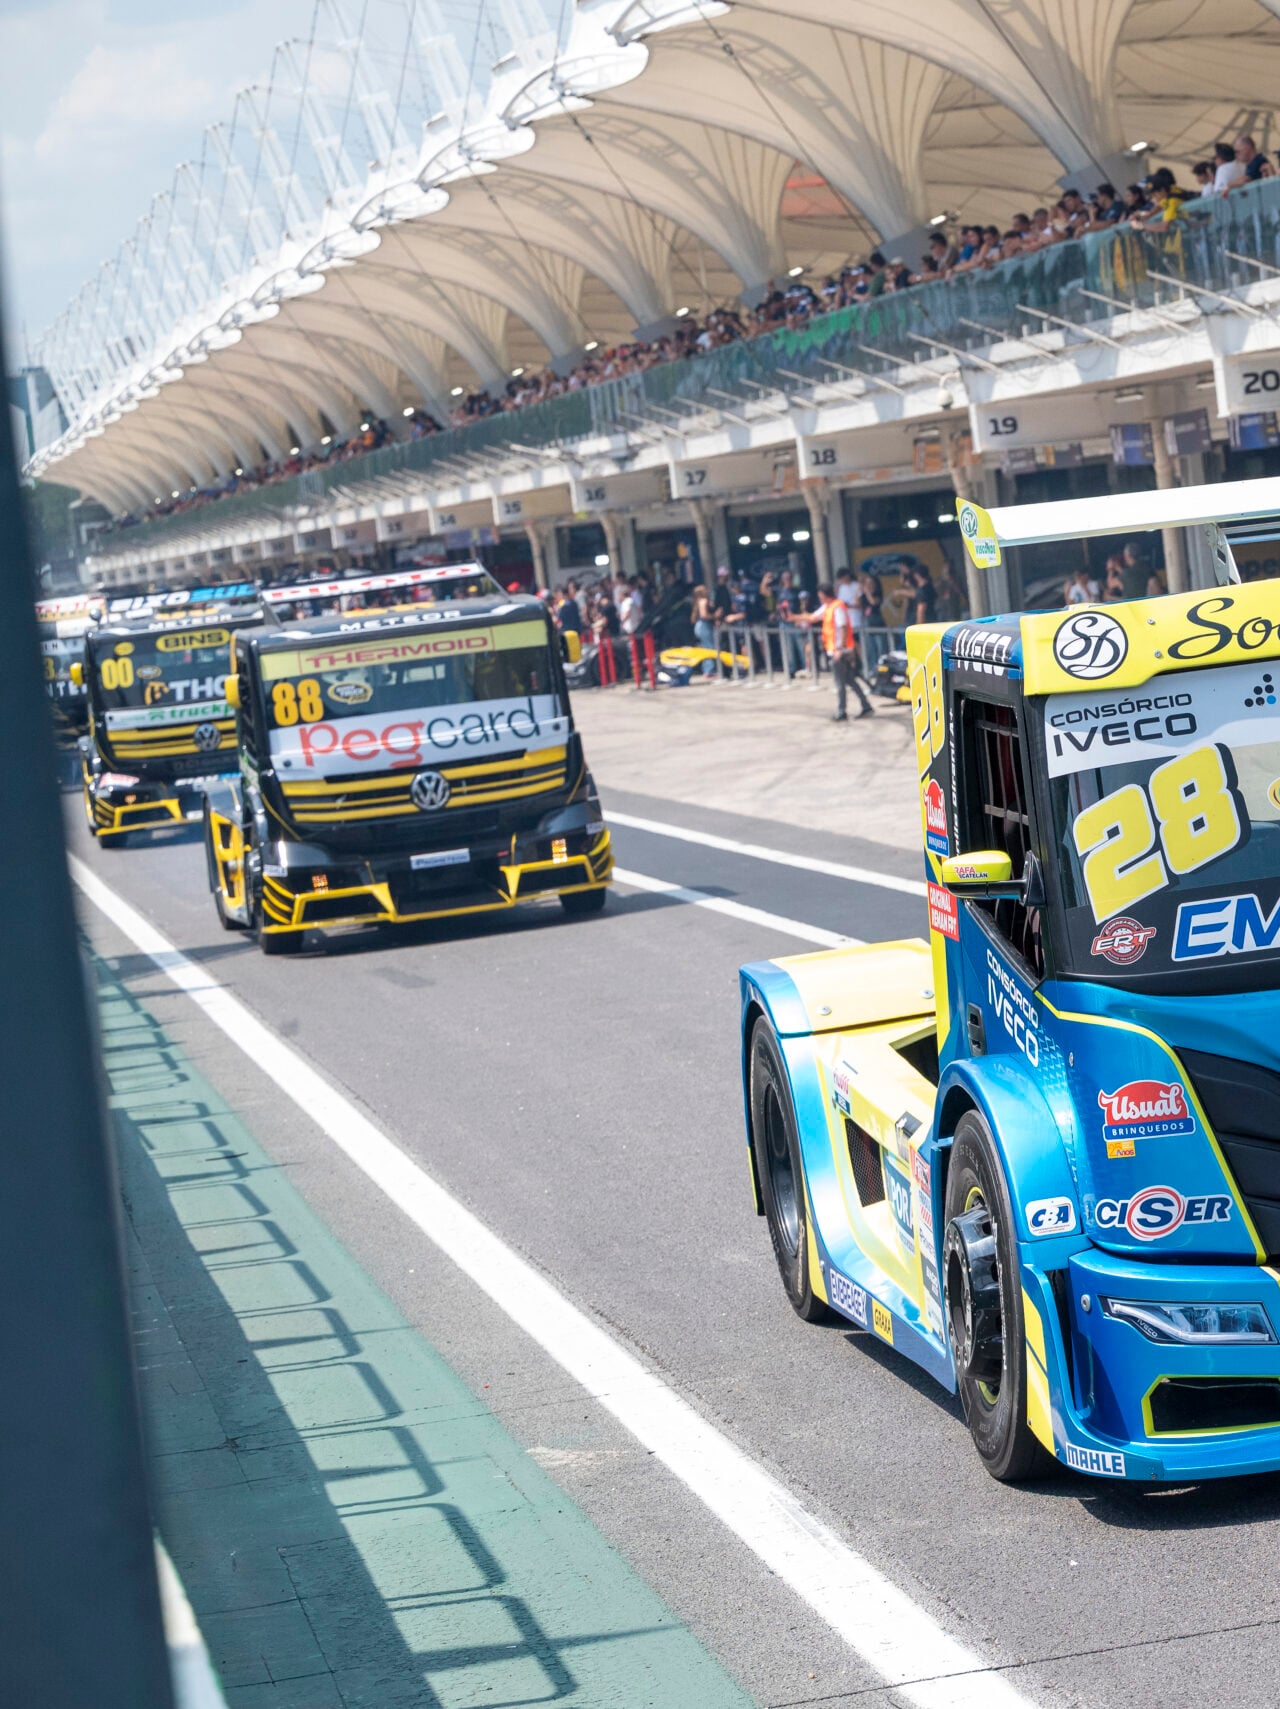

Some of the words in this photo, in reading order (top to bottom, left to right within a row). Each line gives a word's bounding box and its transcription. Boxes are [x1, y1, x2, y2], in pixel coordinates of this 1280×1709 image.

[1243, 370, 1280, 395] 20
[989, 416, 1019, 436] 19
[811, 449, 838, 465] 18
[685, 470, 707, 486] 17
[339, 610, 461, 632] METEOR
[163, 631, 224, 649] BINS
[304, 636, 489, 669] THERMOID
[101, 657, 134, 690] 00
[272, 678, 324, 727] 88
[1050, 693, 1192, 728] CONSÓRCIO
[299, 697, 542, 769] pegcard
[1053, 713, 1198, 757] IVECO
[1073, 743, 1242, 926] 28
[1095, 931, 1152, 951] ERT
[986, 973, 1039, 1068] IVECO
[1101, 1085, 1182, 1121] Usual
[1111, 1122, 1185, 1136] BRINQUEDOS
[1096, 1196, 1230, 1229] CISER
[1136, 1317, 1159, 1338] IVECO
[1066, 1444, 1124, 1474] MAHLE
